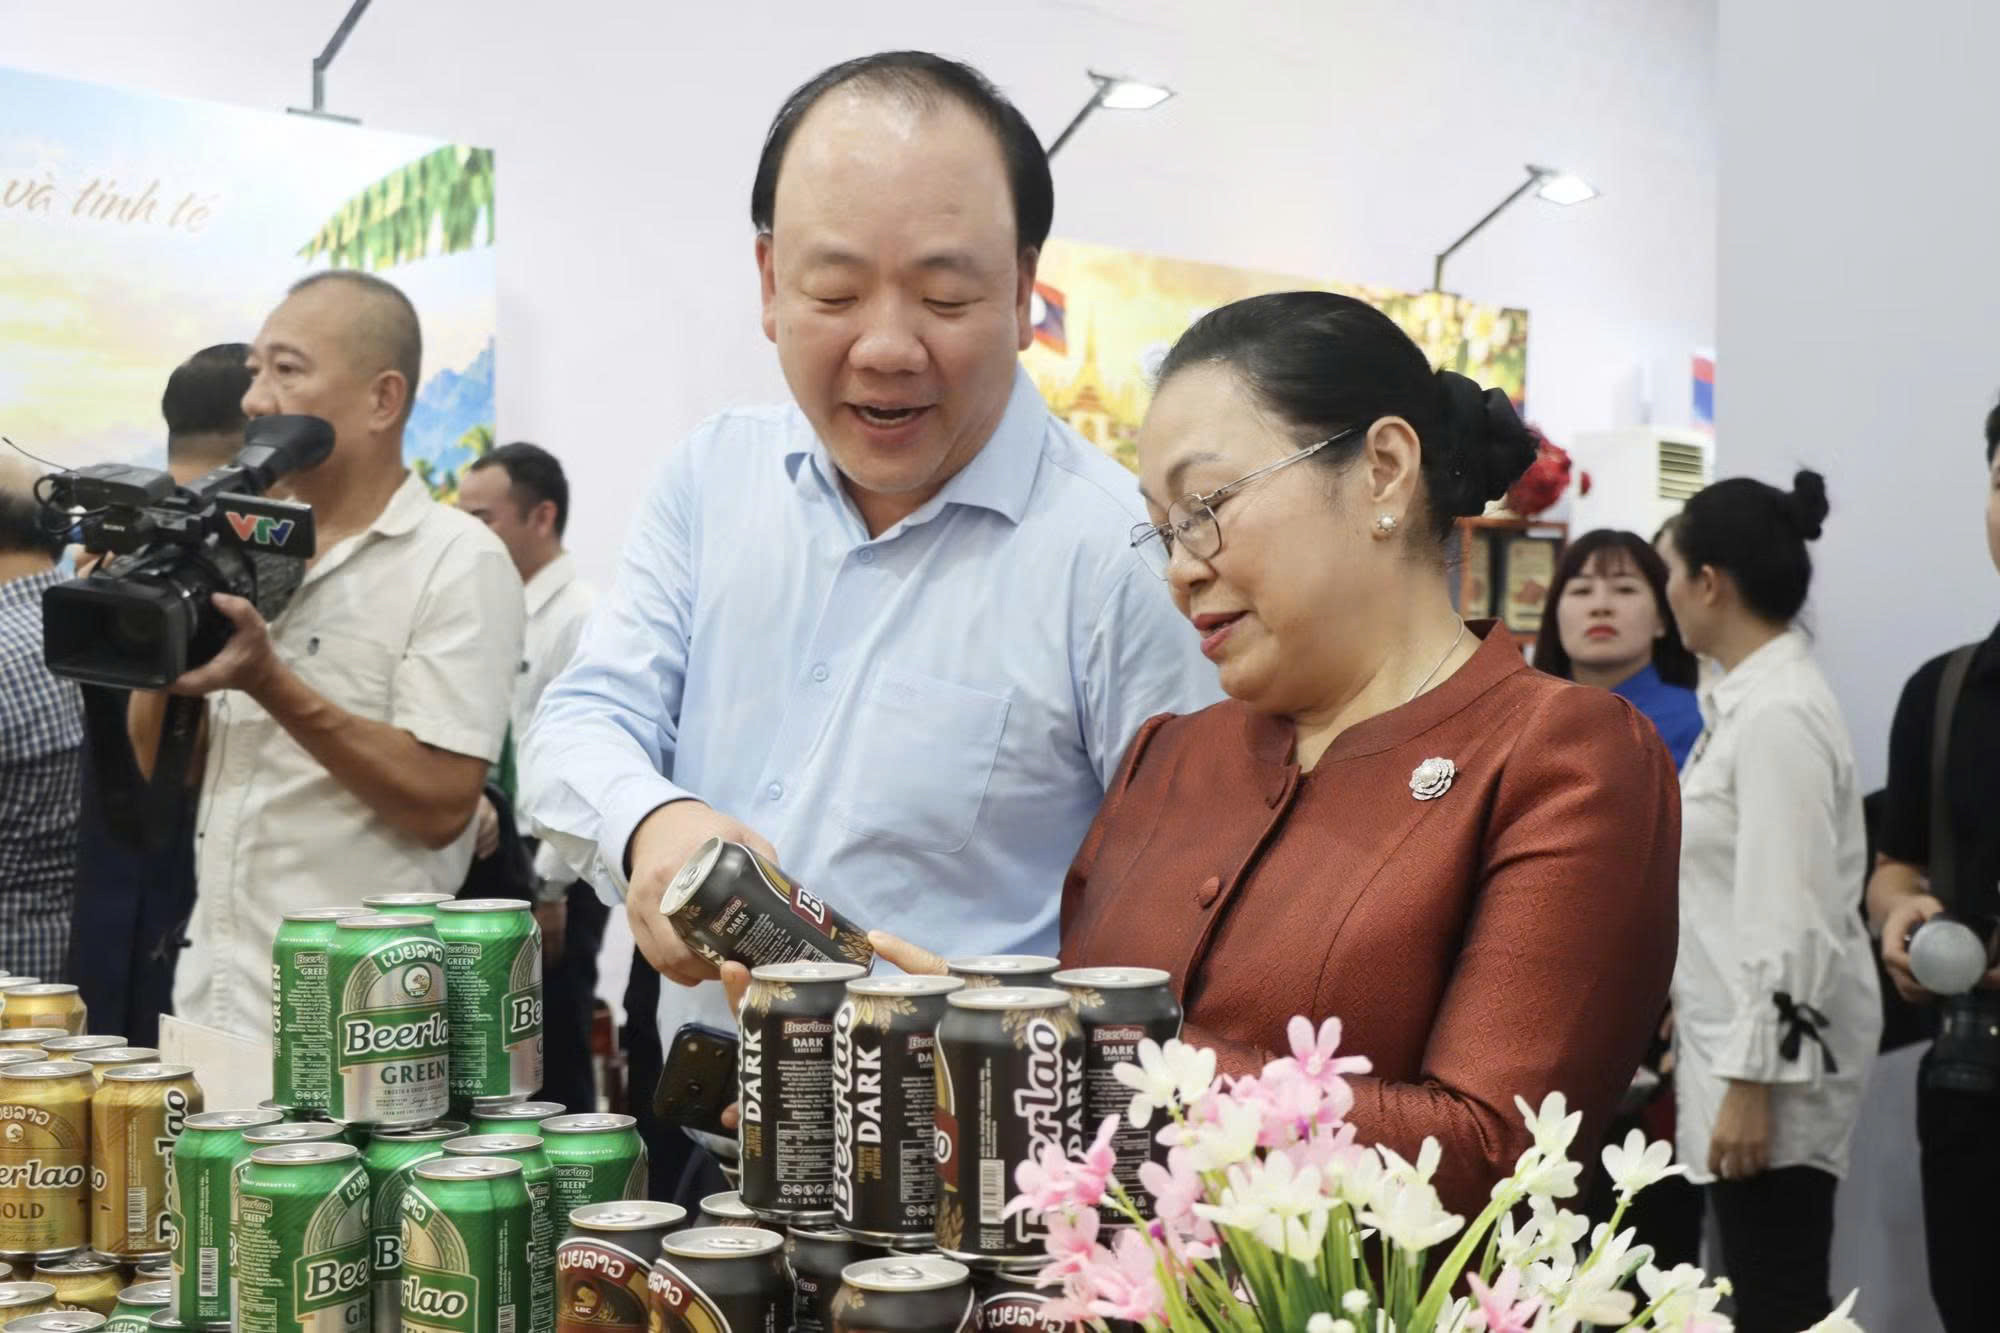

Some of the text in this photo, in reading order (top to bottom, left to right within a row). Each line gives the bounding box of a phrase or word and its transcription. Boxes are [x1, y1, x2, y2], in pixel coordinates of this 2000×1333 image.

[225, 510, 294, 546] VTV
[726, 911, 748, 934] DARK
[343, 1011, 448, 1056] Beerla
[792, 1037, 825, 1048] DARK
[1102, 1045, 1135, 1056] DARK
[380, 1059, 446, 1085] GREEN
[745, 1028, 762, 1123] DARK
[856, 1045, 882, 1144] DARK
[0, 1159, 86, 1189] erlao
[0, 1203, 45, 1219] OLD
